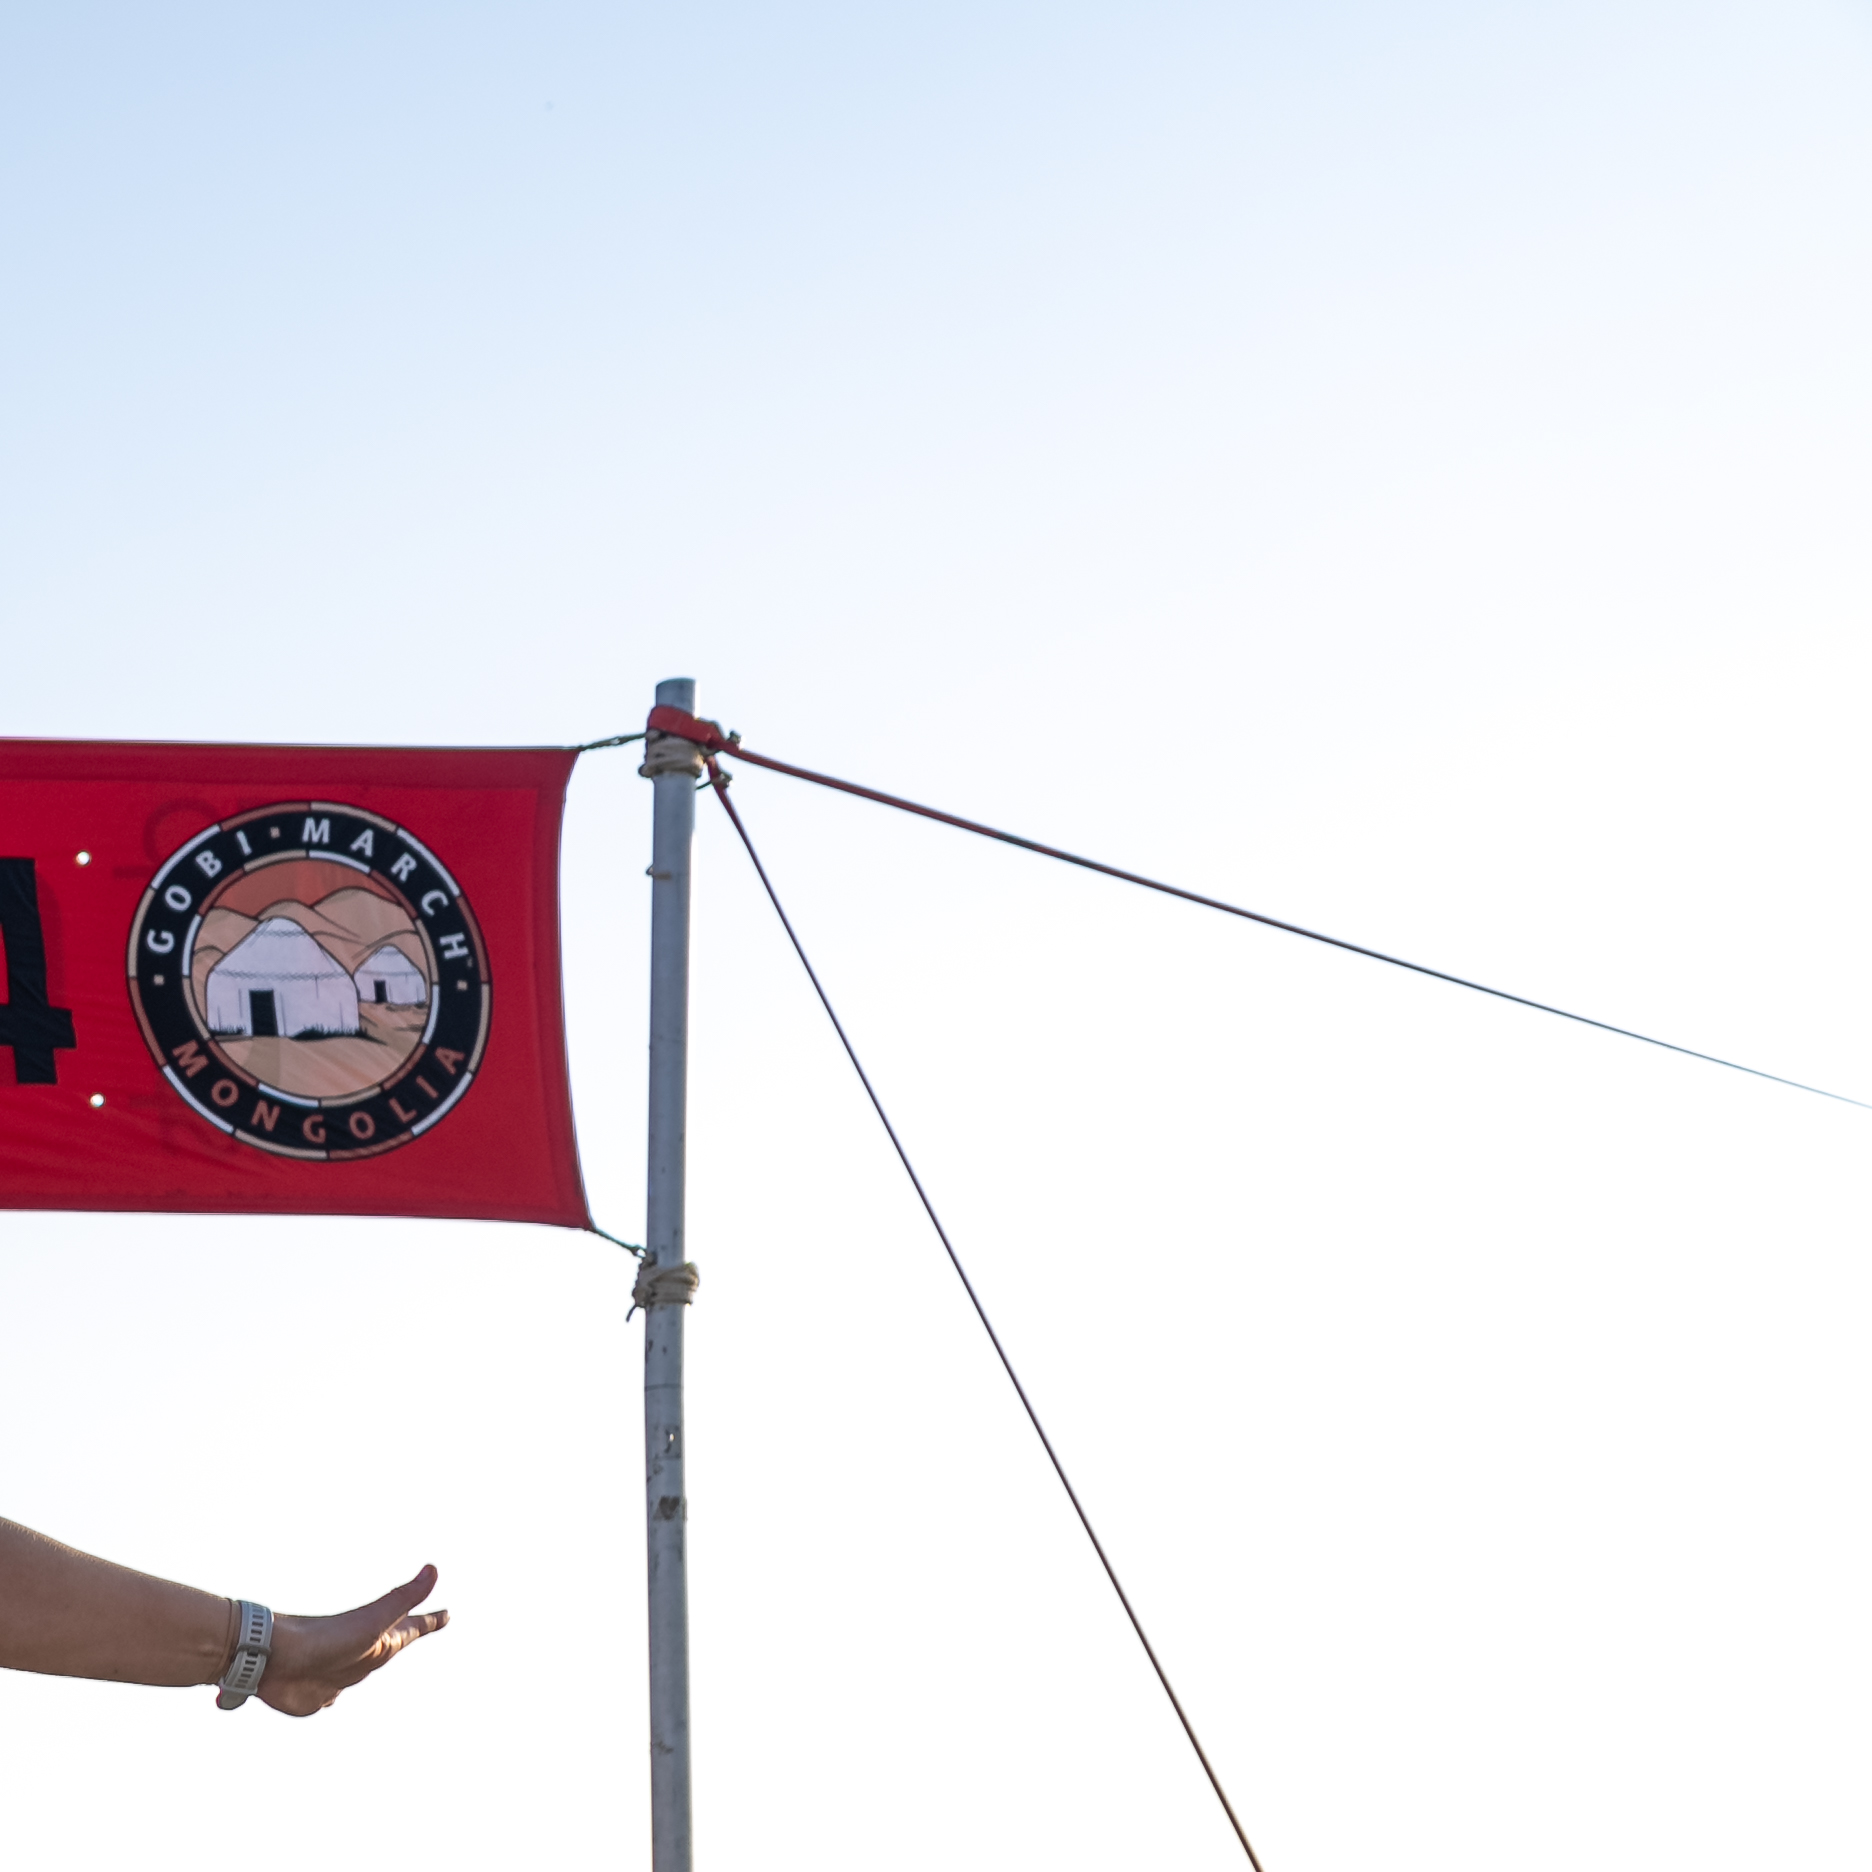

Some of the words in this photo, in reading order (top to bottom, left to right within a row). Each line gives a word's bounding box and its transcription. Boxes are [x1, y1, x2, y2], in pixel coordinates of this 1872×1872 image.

[146, 829, 251, 955] GOBI
[302, 817, 469, 960] MARCH
[171, 1039, 466, 1144] MONGOLIA
